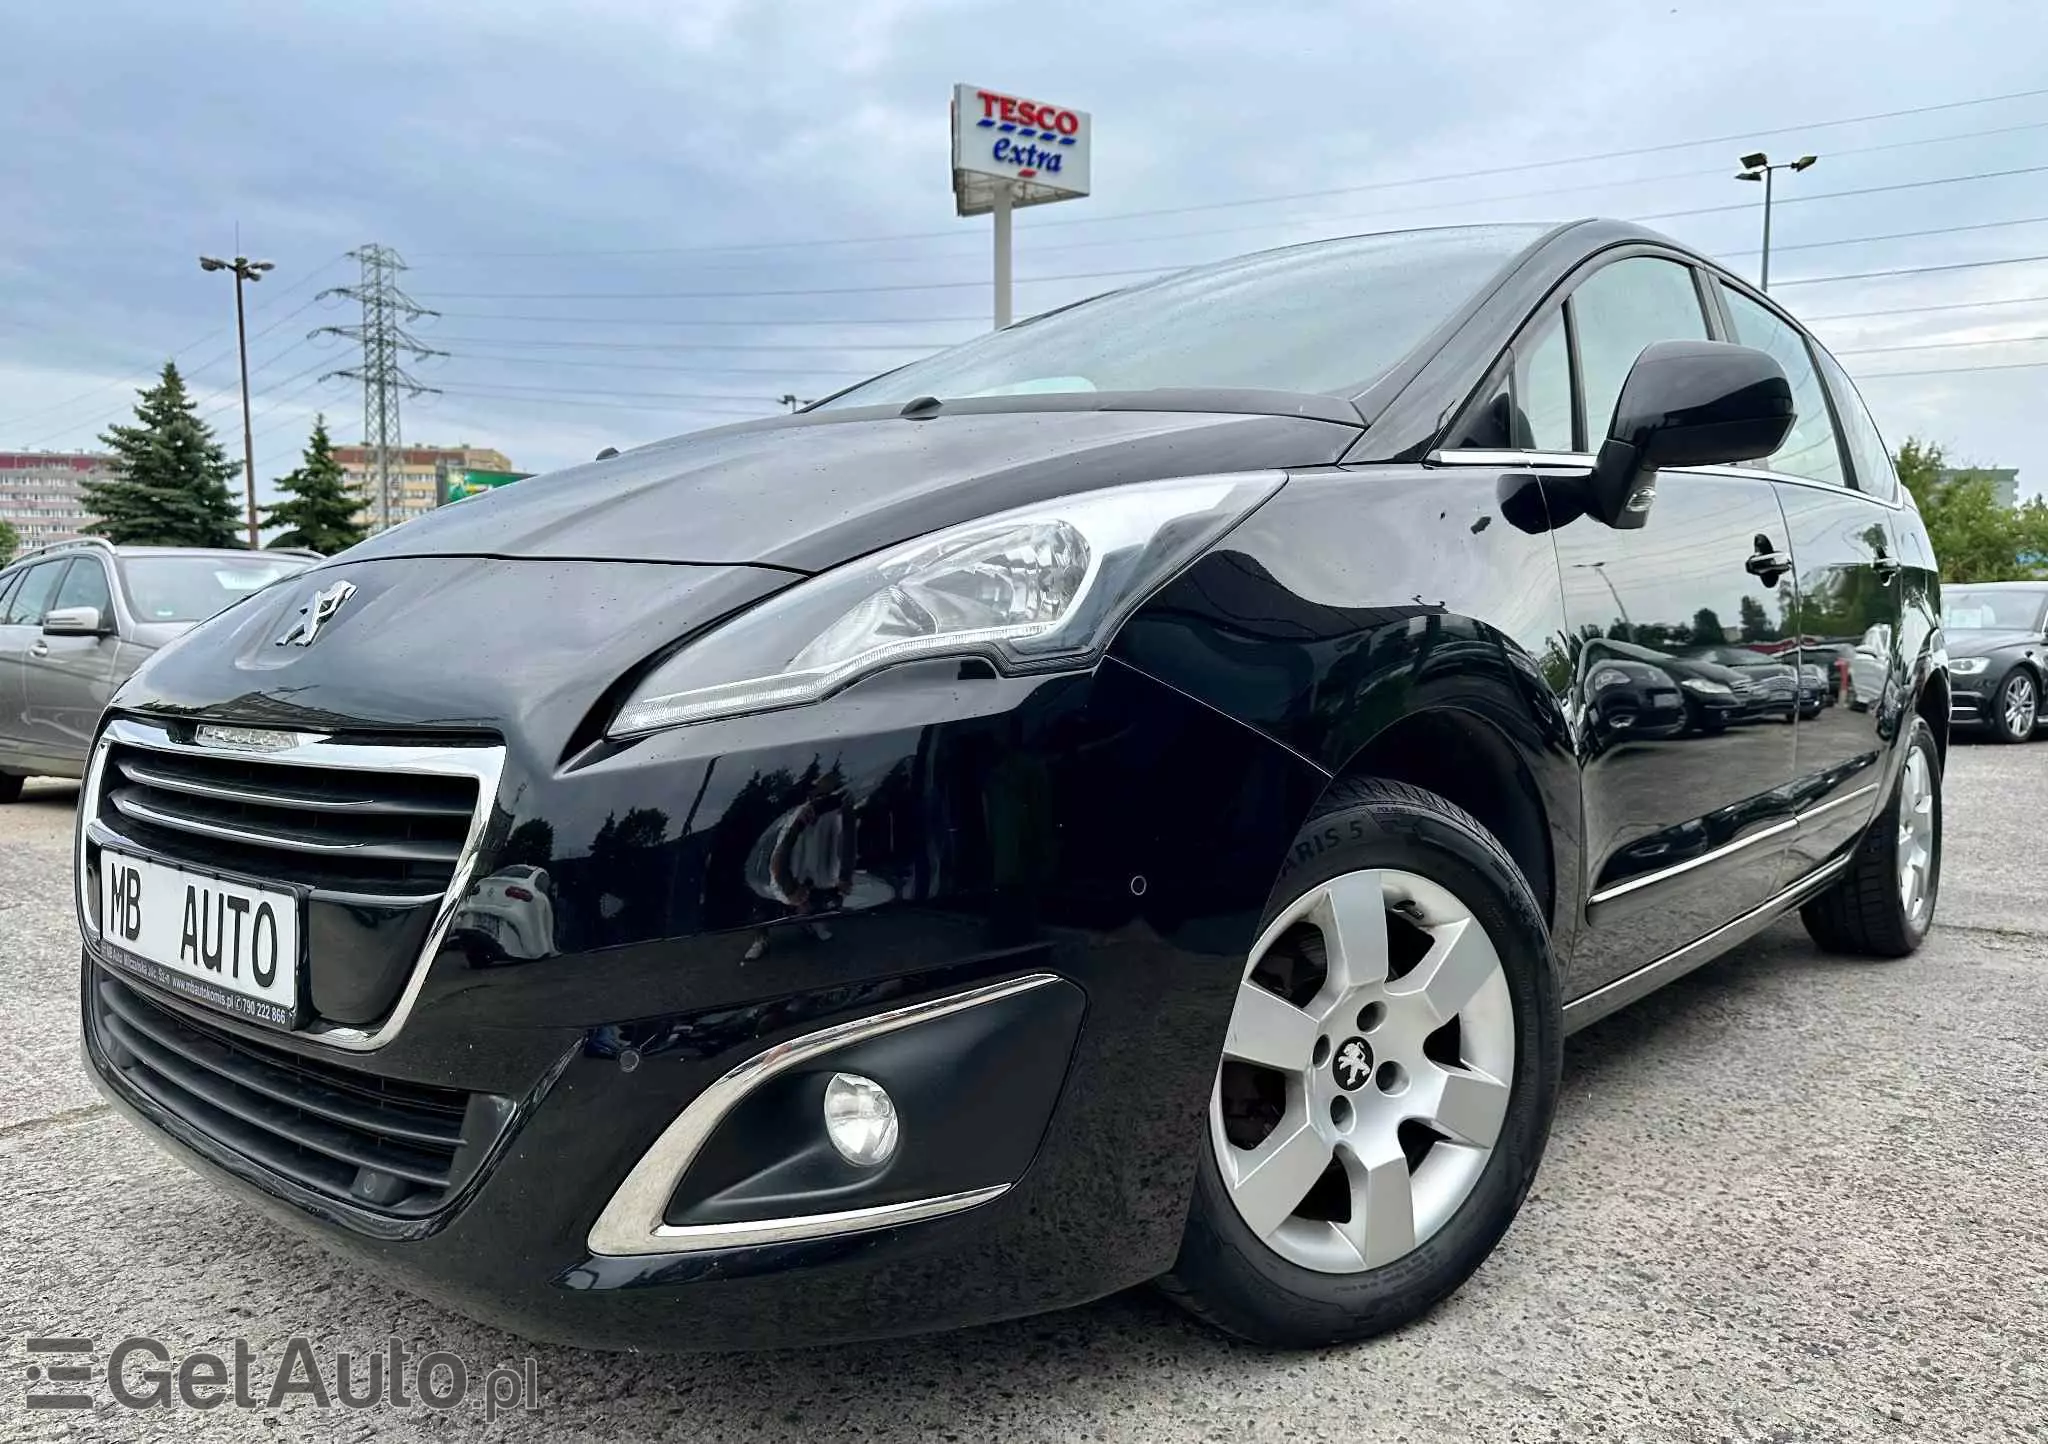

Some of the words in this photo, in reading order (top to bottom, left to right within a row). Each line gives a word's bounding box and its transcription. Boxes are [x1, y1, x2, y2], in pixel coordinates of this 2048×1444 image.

[976, 90, 1079, 135] TESCO
[993, 138, 1062, 172] extra
[111, 863, 141, 941] MB
[180, 885, 278, 988] AUTO
[172, 975, 234, 1009] www.mbautokomis.pl
[257, 1003, 270, 1019] 222
[271, 1007, 286, 1024] 866
